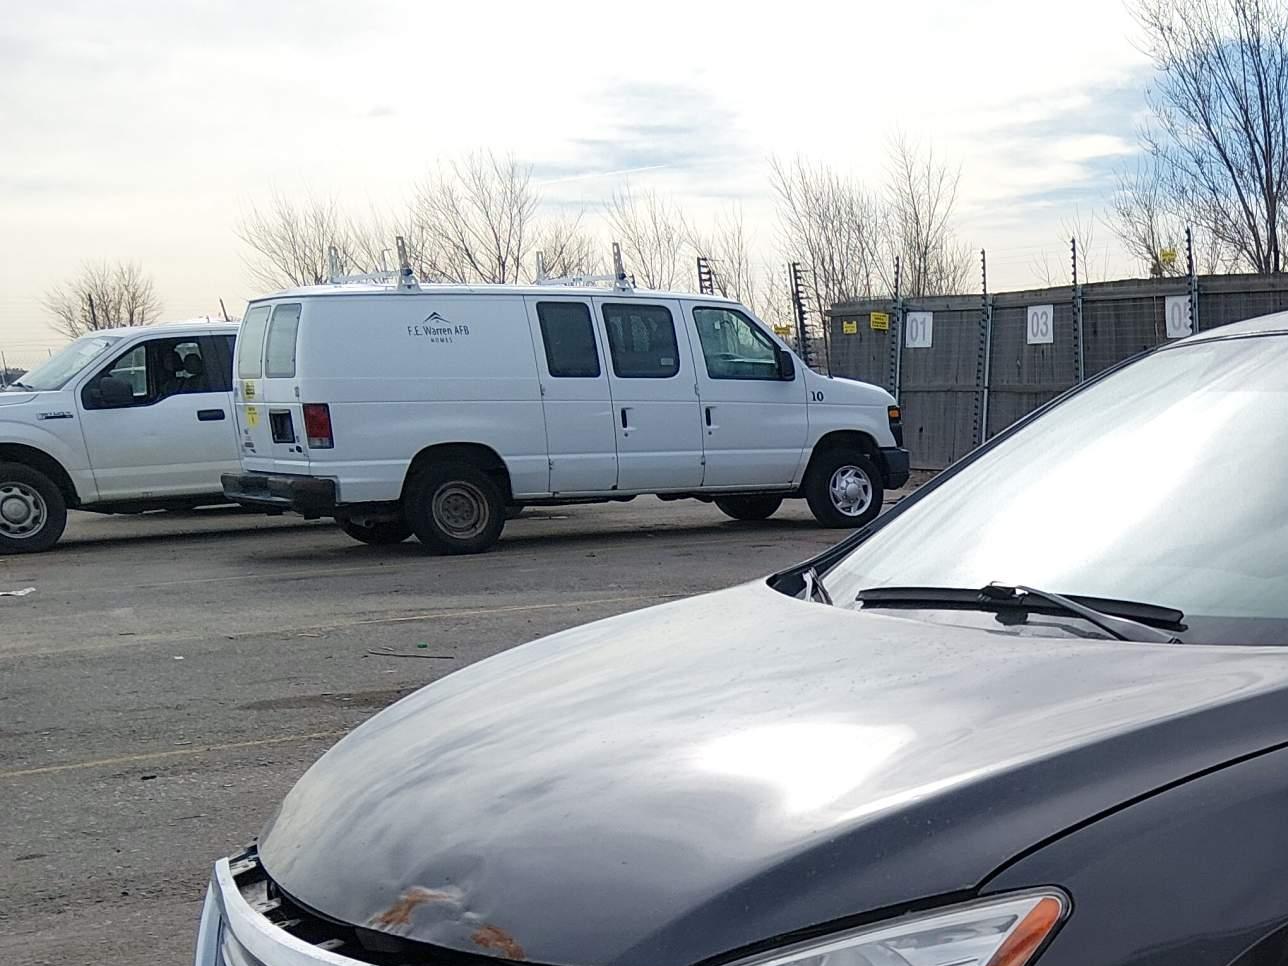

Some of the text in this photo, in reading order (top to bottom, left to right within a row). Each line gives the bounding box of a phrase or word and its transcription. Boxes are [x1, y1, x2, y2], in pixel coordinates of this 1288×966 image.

[423, 326, 453, 336] Warren
[454, 326, 470, 336] AFB
[910, 318, 926, 343] 01
[1031, 311, 1049, 338] 03
[811, 391, 824, 402] 10
